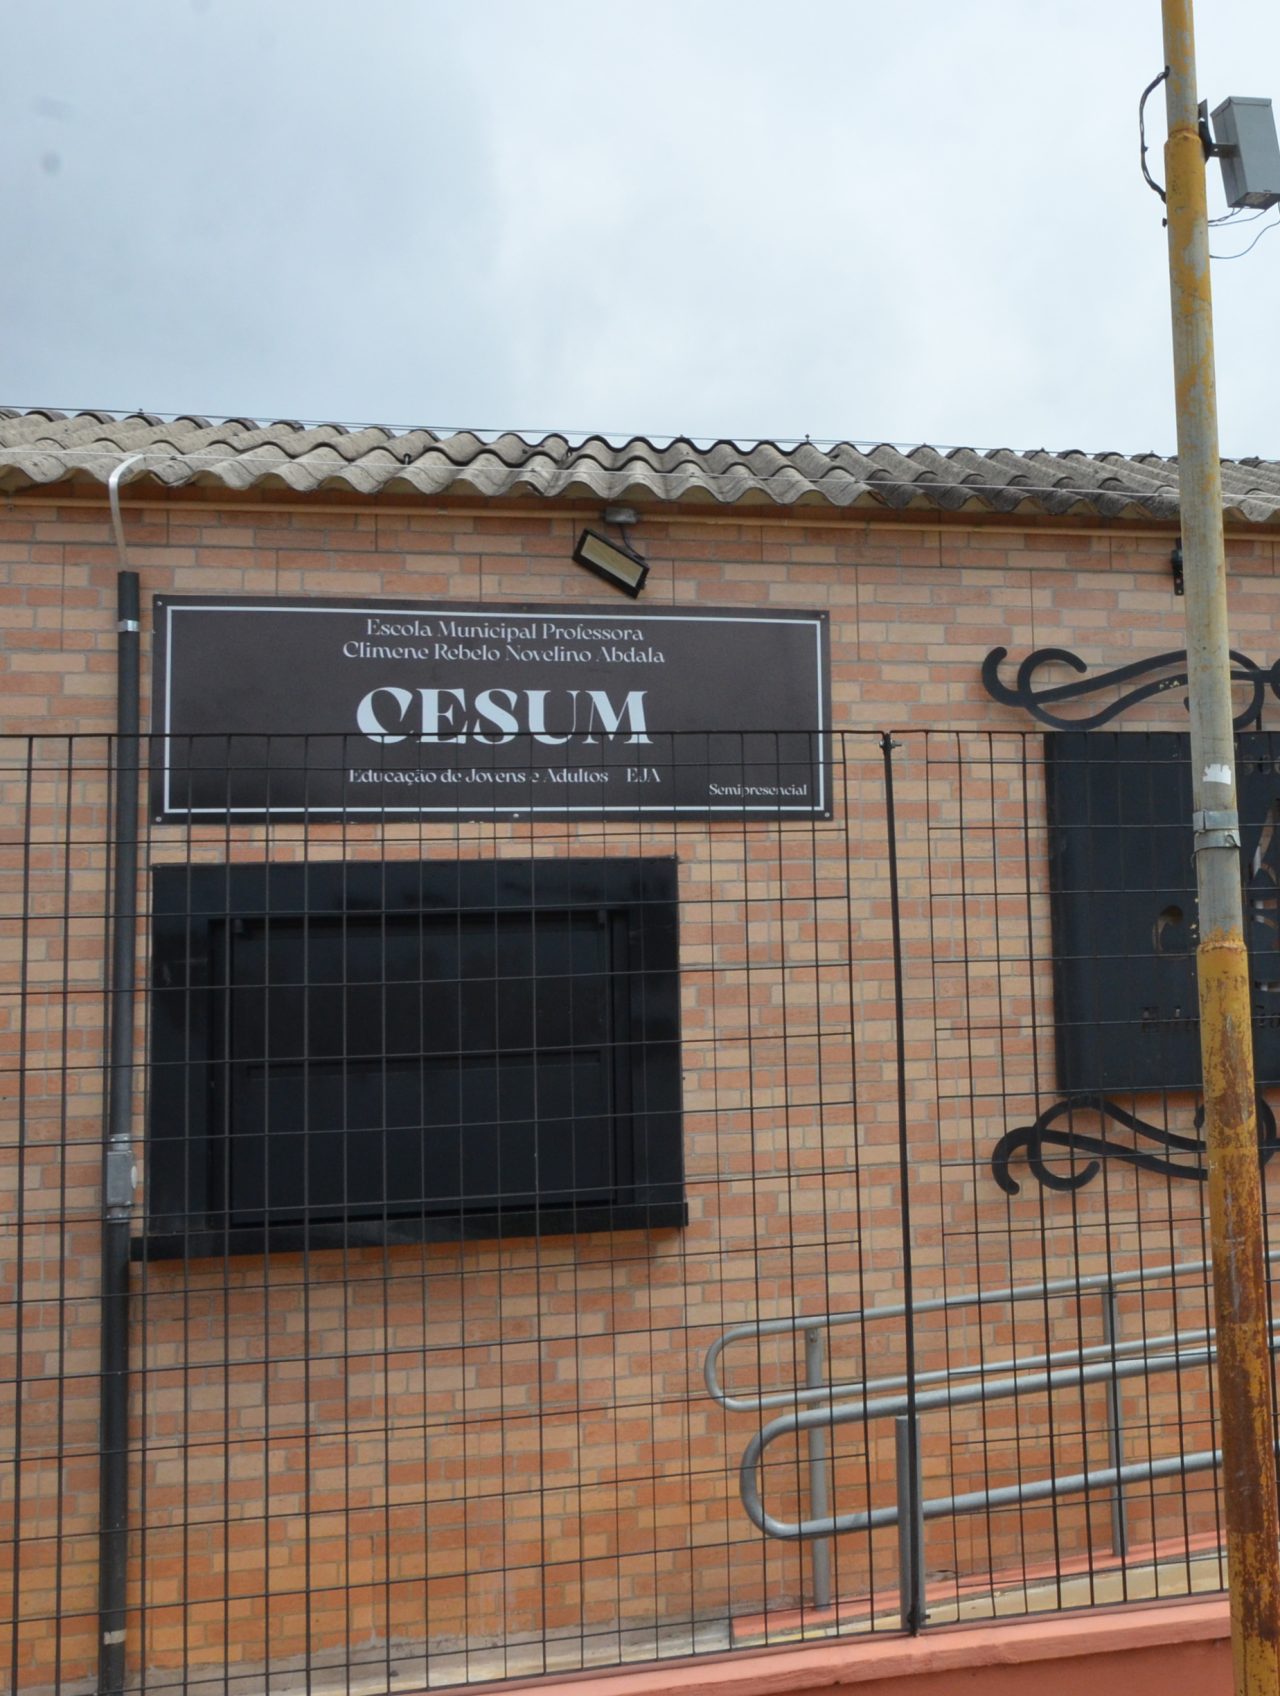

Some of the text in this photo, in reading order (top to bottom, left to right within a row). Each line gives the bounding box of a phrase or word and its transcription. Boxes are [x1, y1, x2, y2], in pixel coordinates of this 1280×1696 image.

[367, 619, 644, 642] Escola Municipal Professora
[343, 641, 665, 663] Climene Rebelo Novelino Abdala
[356, 687, 653, 744] CESUM
[350, 767, 661, 786] Educação de Jovens e Adultos EJA
[709, 784, 807, 798] Semipresencial
